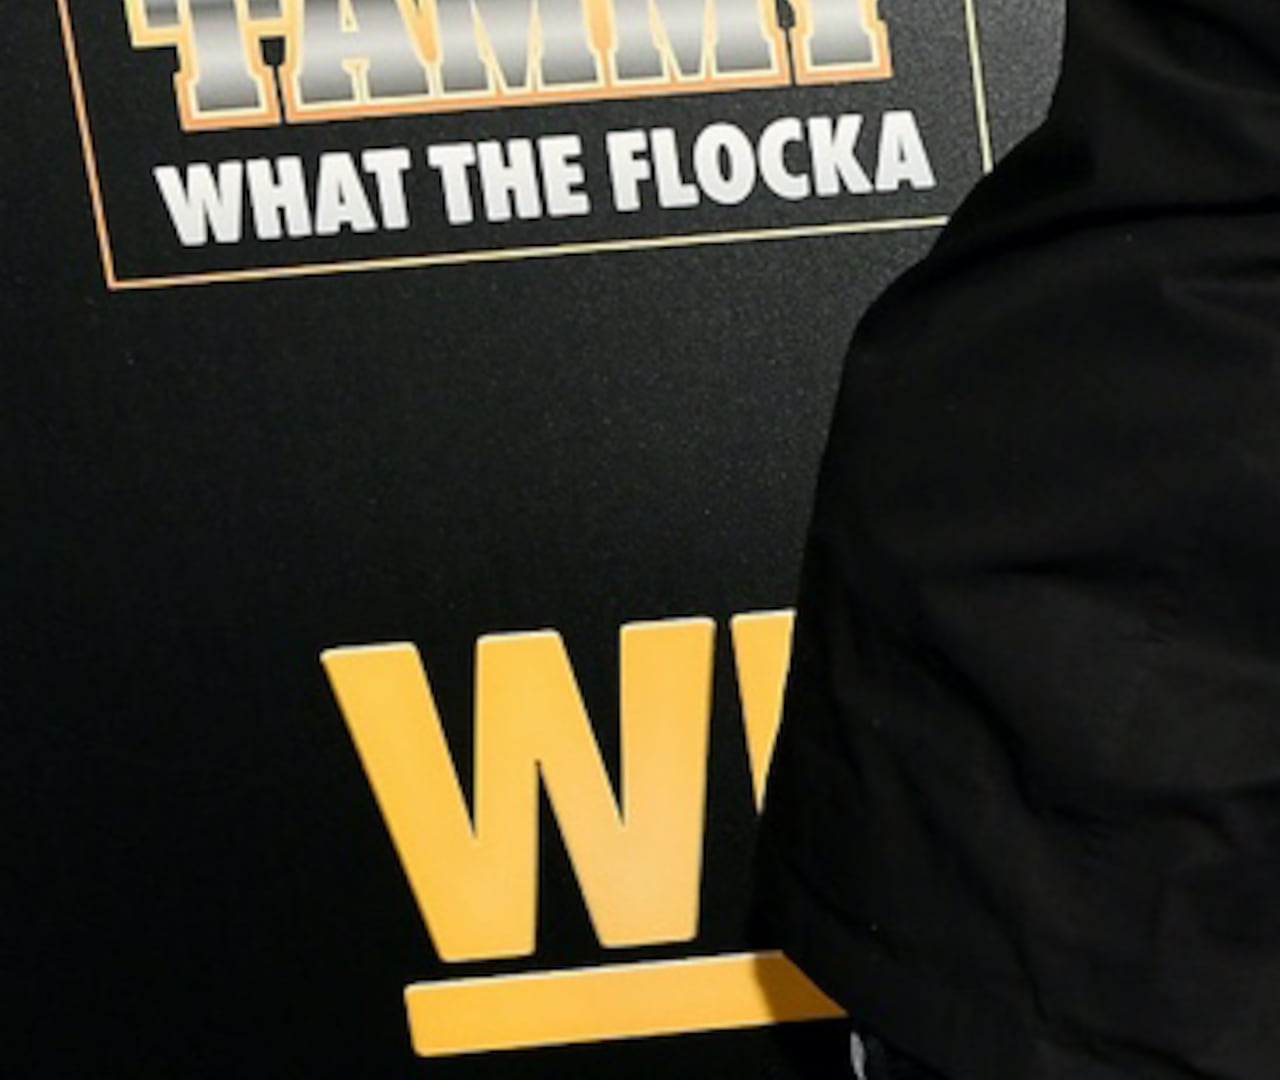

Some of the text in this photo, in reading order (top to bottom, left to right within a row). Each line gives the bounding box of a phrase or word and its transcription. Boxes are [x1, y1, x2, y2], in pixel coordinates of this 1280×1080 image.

[153, 111, 936, 247] WHAT THE FLOCKA
